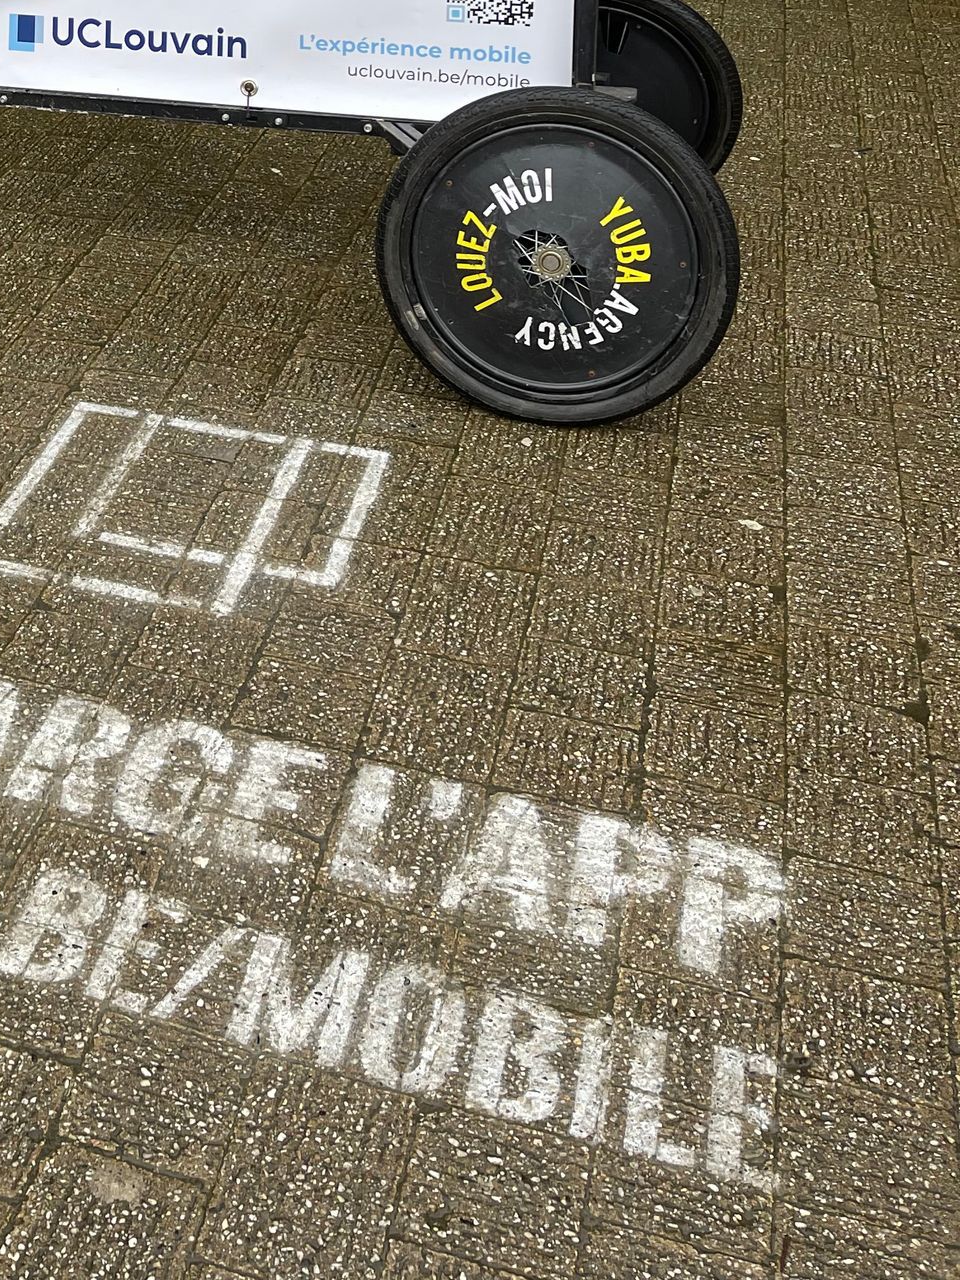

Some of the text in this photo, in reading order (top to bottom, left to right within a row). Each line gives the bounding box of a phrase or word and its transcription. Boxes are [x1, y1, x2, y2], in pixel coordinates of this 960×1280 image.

[51, 15, 248, 60] UCLouvain
[298, 33, 532, 65] L'expérience mobile
[346, 64, 531, 88] uclouvain.be/mobile
[455, 167, 553, 312] LOUEZ-MOI
[331, 762, 788, 974] L'APP
